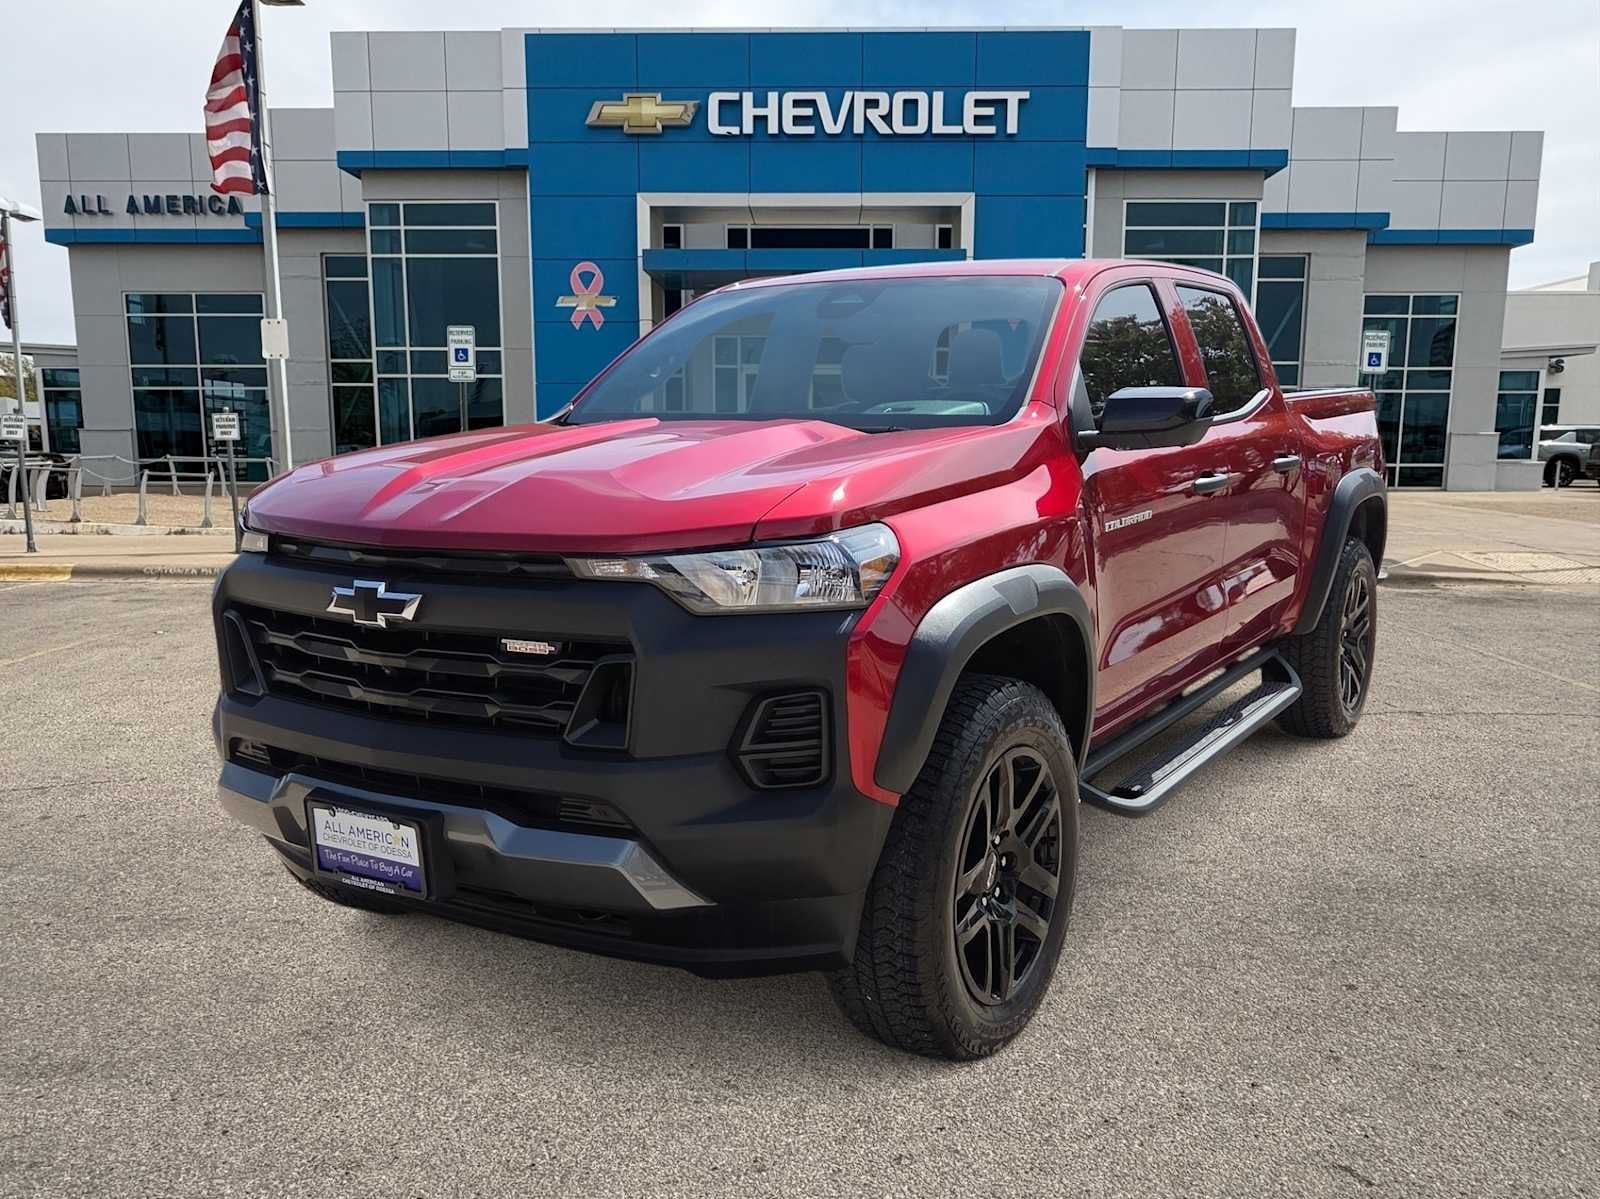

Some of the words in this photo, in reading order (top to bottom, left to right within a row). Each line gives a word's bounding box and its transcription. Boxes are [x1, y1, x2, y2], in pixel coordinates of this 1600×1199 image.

[707, 91, 1030, 135] CHEVROLET
[64, 195, 112, 215] ALL
[126, 195, 243, 216] AMERICA
[1104, 510, 1153, 532] COLORADO
[322, 833, 366, 849] CHEVROLET
[368, 842, 379, 851] OF
[381, 846, 413, 860] ODESSA
[324, 820, 345, 835] ALL
[348, 825, 410, 849] AMERICN
[324, 849, 337, 861] The
[351, 854, 369, 867] Place
[369, 859, 379, 870] To
[379, 861, 394, 877] Buy
[394, 865, 401, 875] A
[401, 867, 414, 878] Car
[342, 877, 368, 889] CHEVROLET
[360, 877, 385, 887] AMERICAN
